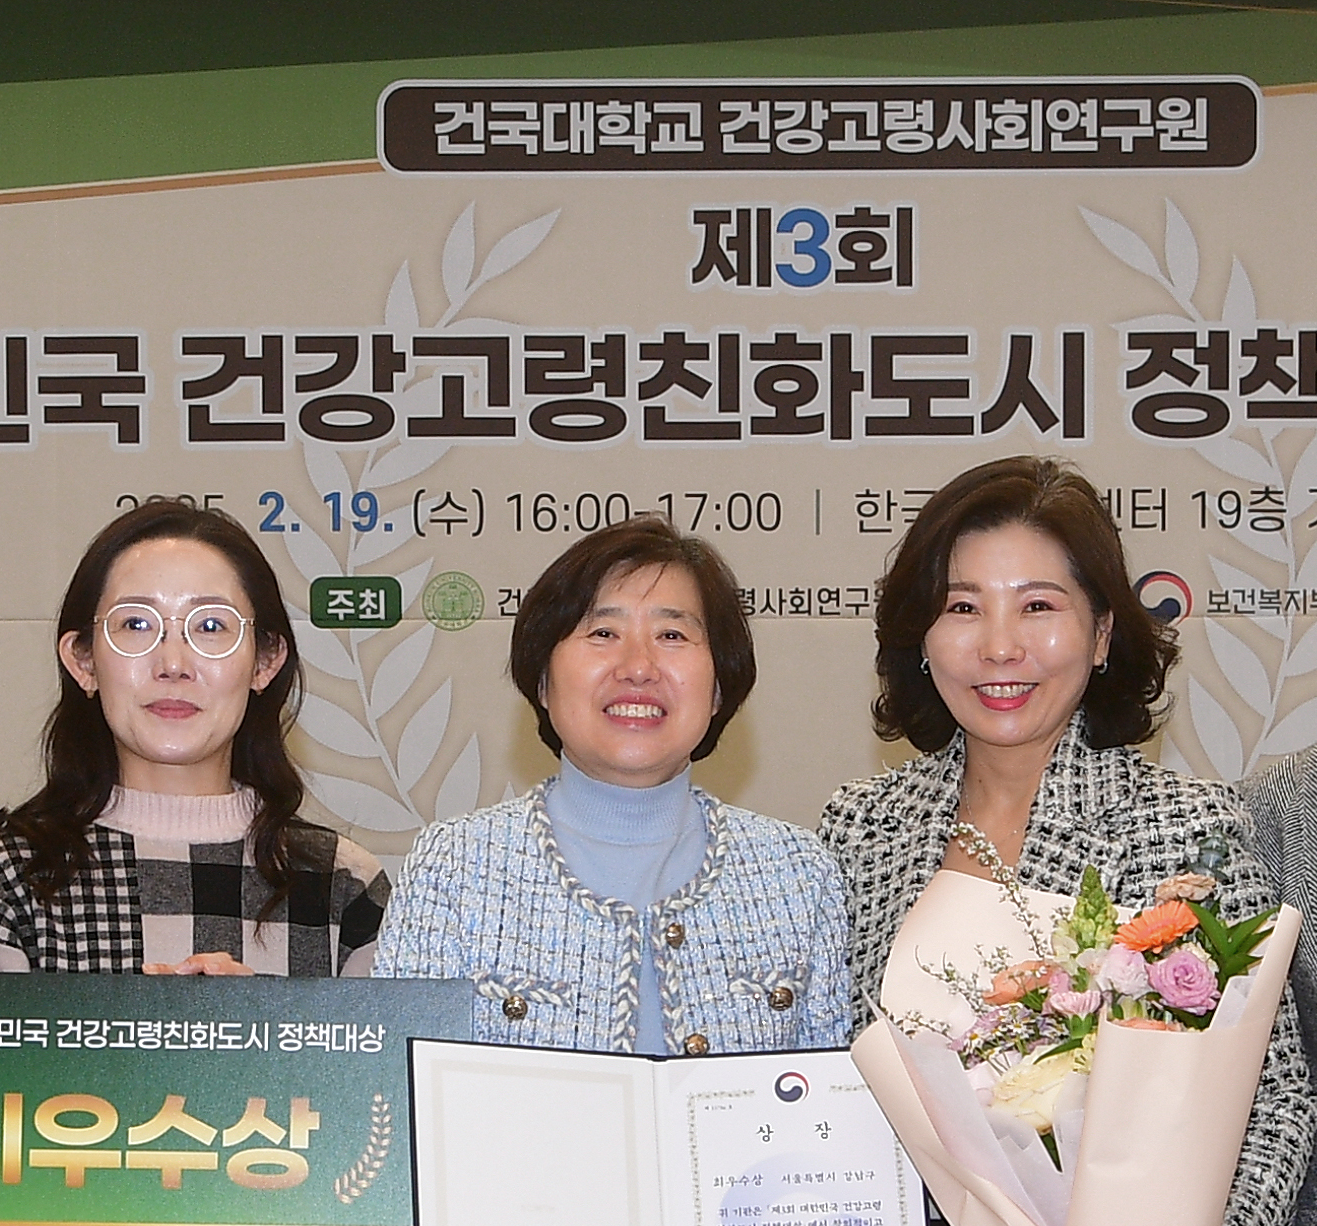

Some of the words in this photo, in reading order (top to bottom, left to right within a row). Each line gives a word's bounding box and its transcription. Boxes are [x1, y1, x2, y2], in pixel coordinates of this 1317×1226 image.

[433, 100, 704, 154] 건국대학교
[718, 97, 1209, 154] 건강고령사회연구원
[691, 206, 914, 290] 제3회
[180, 330, 1083, 446] 건강고령친화도시
[258, 491, 300, 532] 2.
[323, 491, 394, 532] 19.
[413, 488, 485, 537] (수)
[1191, 486, 1287, 532] 19층
[326, 589, 386, 621] 주최
[56, 1020, 270, 1053] 건강고령친화도시
[278, 1022, 386, 1054] 정책대상
[757, 1123, 774, 1143] 상
[814, 1121, 832, 1140] 장
[713, 1174, 764, 1188] 최우수상
[781, 1171, 837, 1185] 서울특별시
[843, 1170, 876, 1182] 강남구
[800, 1202, 839, 1214] 대한민국
